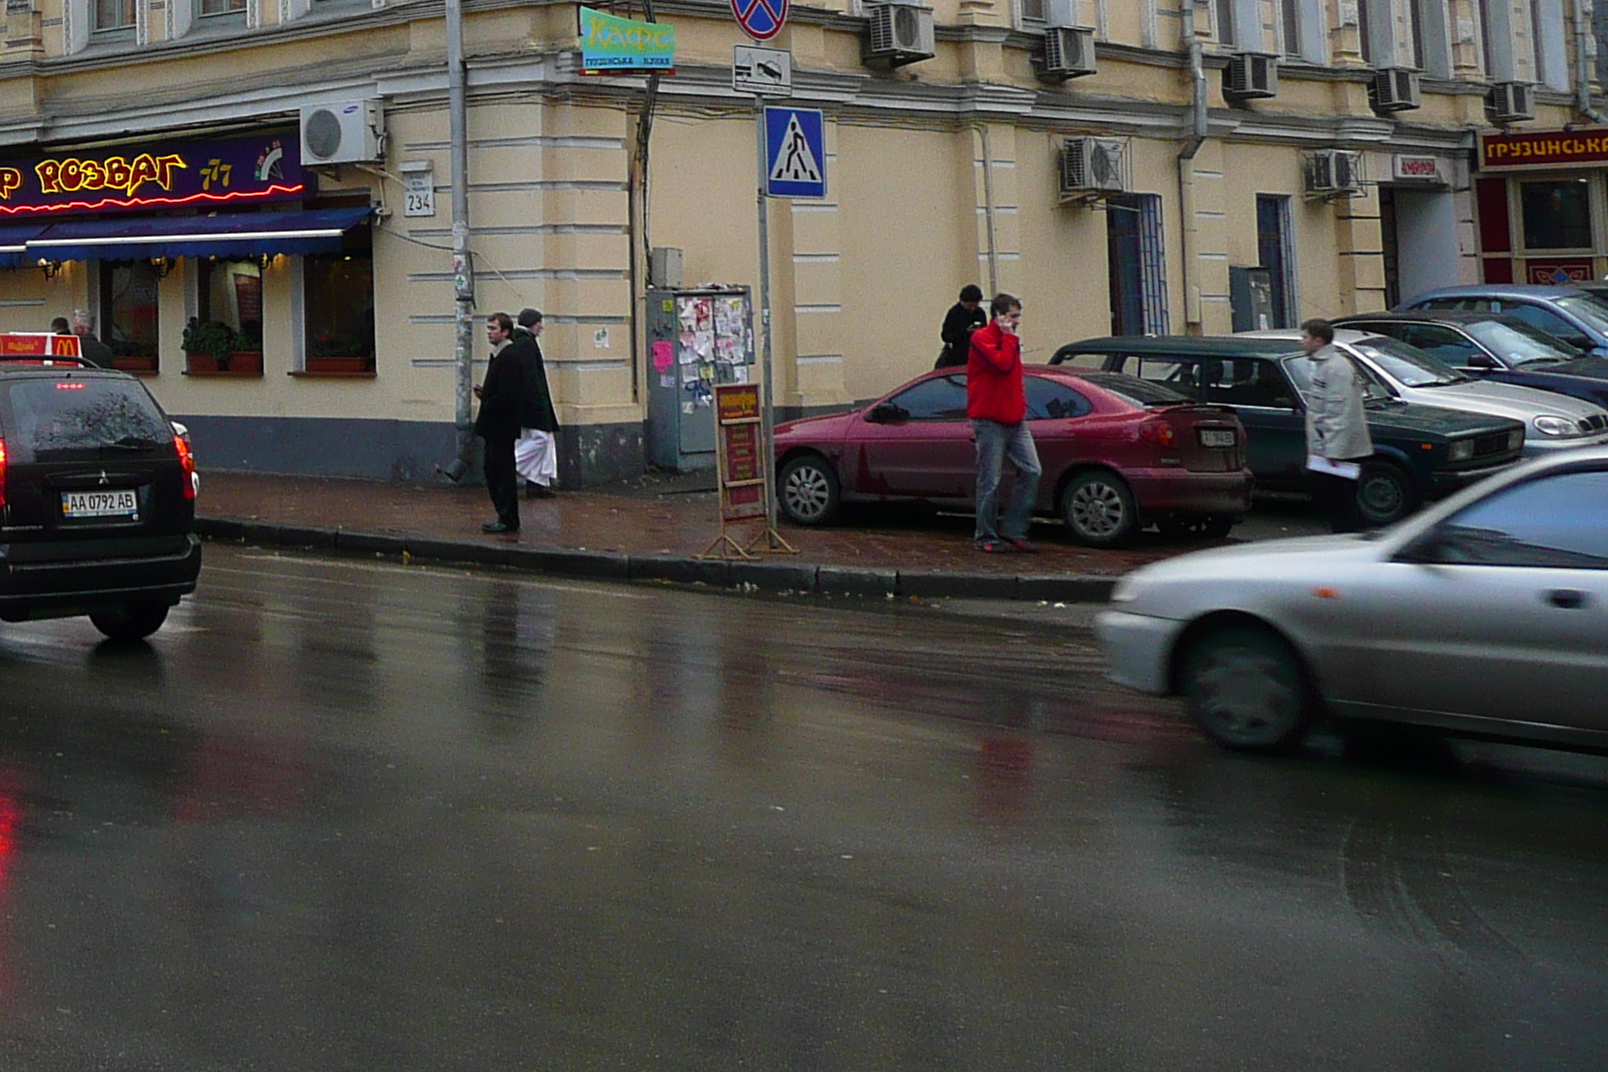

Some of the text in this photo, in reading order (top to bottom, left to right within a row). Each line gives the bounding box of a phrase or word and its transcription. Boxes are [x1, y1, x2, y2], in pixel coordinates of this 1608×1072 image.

[35, 153, 188, 198] РОЗВАГ
[71, 493, 134, 511] AA 0792 AB
